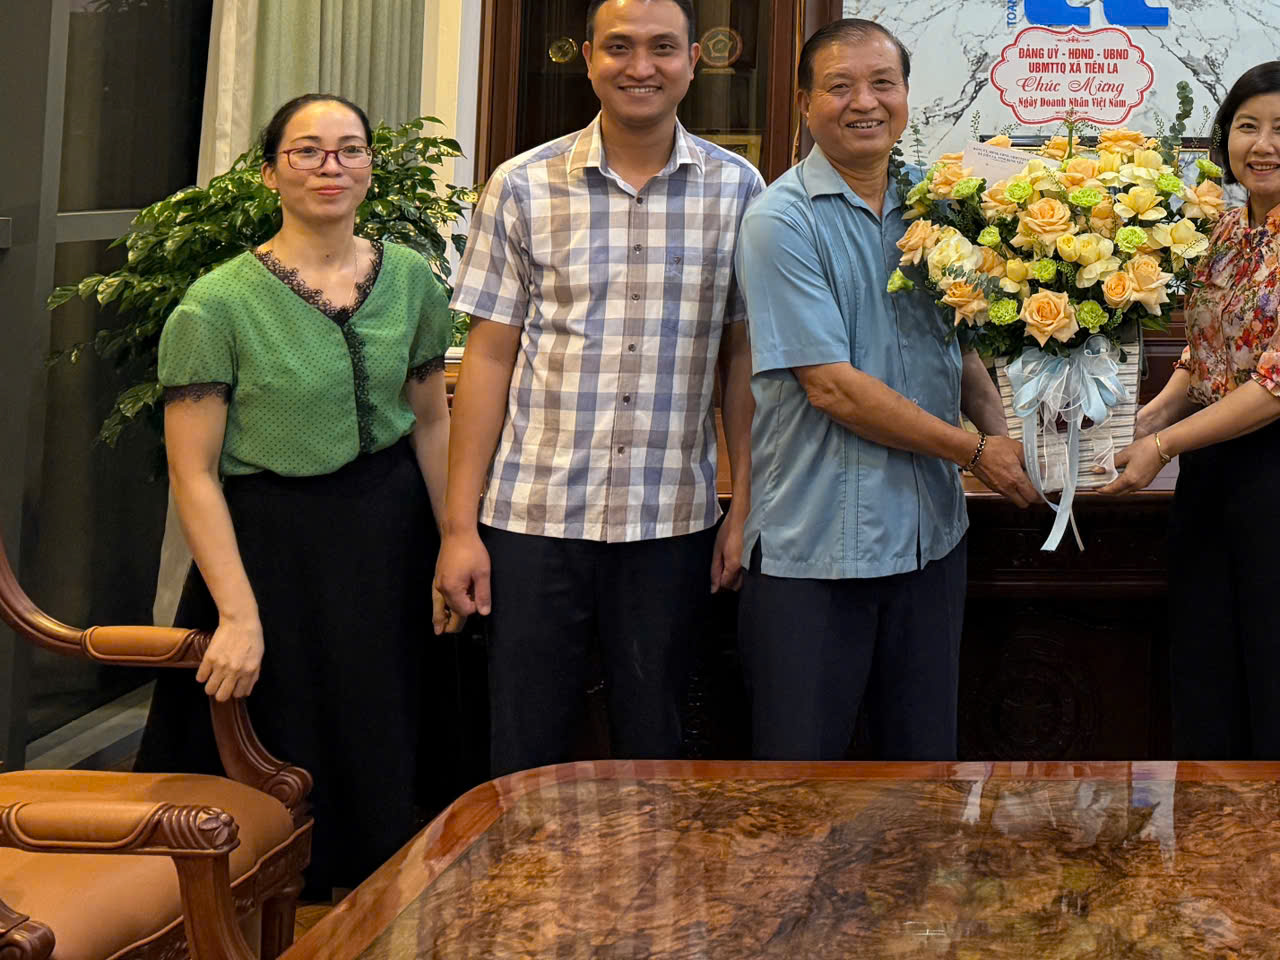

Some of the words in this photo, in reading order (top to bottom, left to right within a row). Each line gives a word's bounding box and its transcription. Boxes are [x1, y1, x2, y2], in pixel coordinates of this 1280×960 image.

[1068, 48, 1094, 59] HĐND
[1103, 48, 1129, 60] UBND
[1029, 62, 1066, 74] UBMTTQ
[1107, 63, 1118, 74] LA
[1016, 76, 1060, 92] Chúc
[1018, 96, 1038, 109] Ngày
[1040, 97, 1066, 107] Doanh
[1091, 97, 1106, 110] Việt
[1108, 98, 1126, 108] Nam
